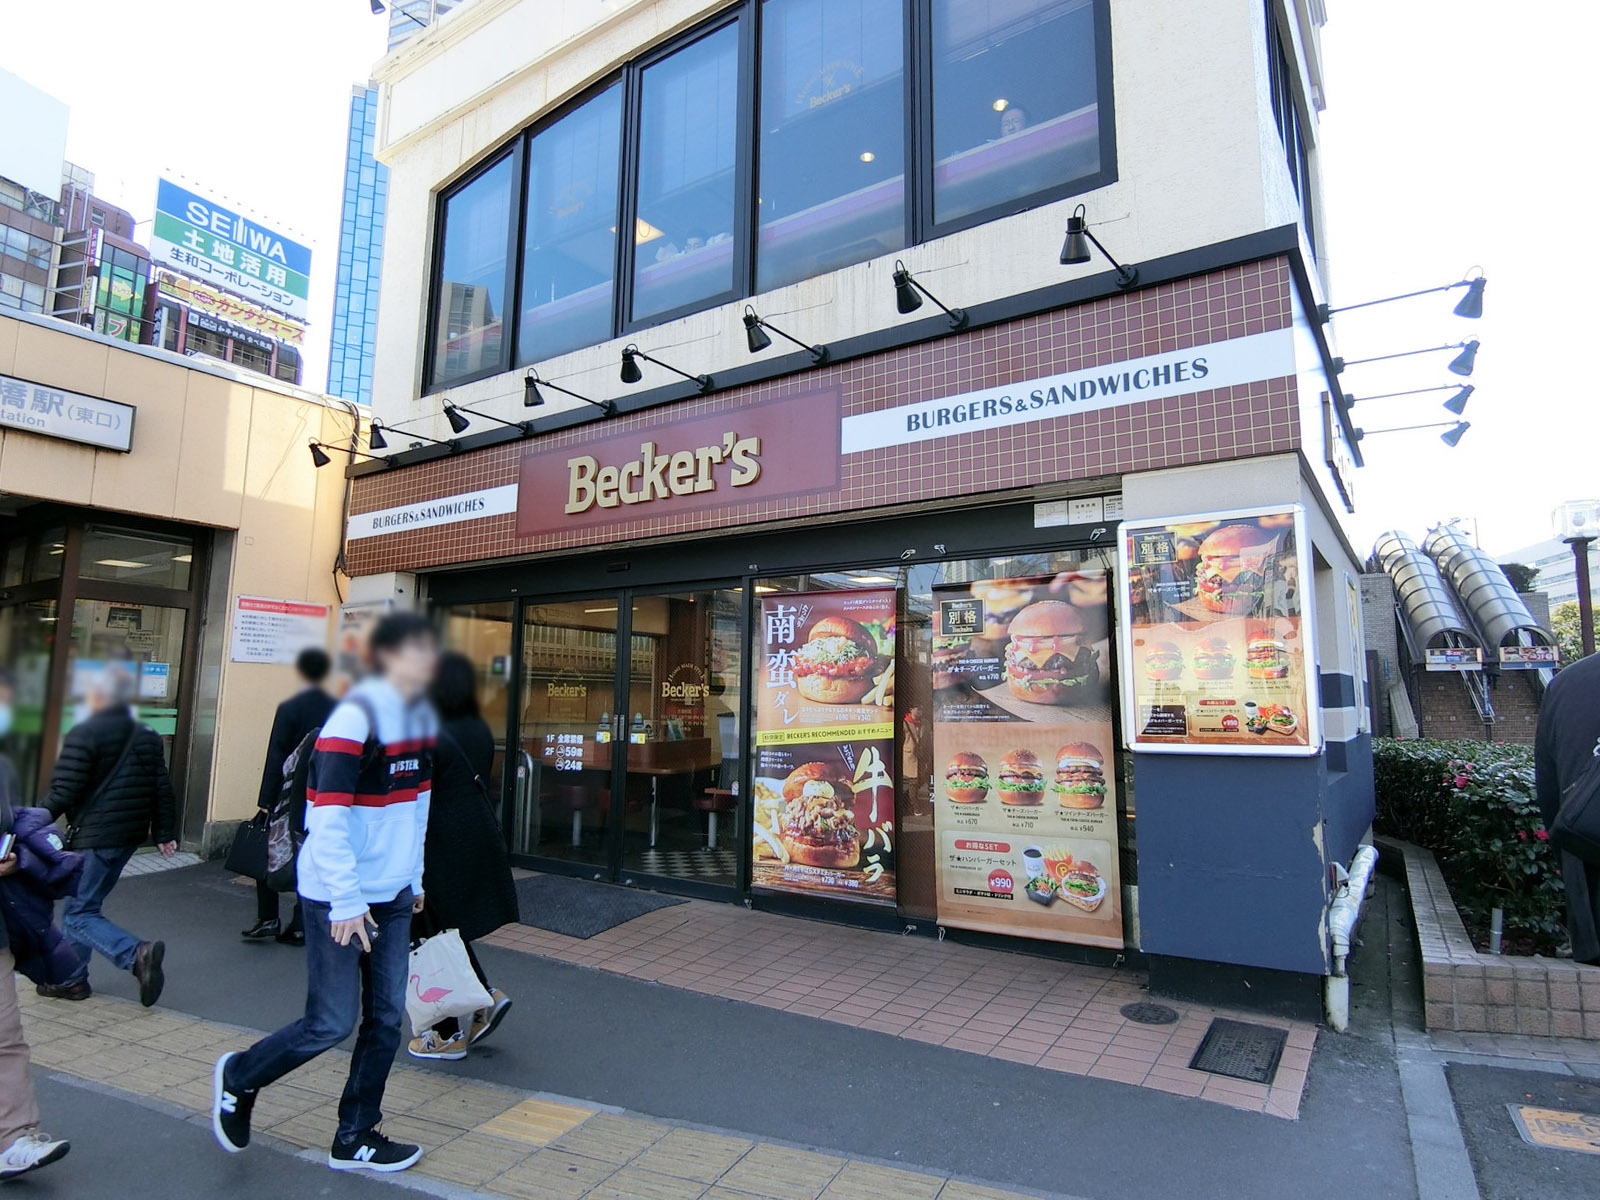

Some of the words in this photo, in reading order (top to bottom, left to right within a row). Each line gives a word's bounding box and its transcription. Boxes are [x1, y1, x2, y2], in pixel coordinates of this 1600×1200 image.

[183, 229, 288, 288] 土地活用
[170, 246, 294, 307] 生和コーポレーション
[907, 357, 1209, 433] BURGERS&SANDWICHES
[565, 431, 761, 514] Becker's
[372, 497, 485, 530] BURGERS&SANDWICHES
[948, 610, 977, 625] 別格
[547, 683, 587, 697] Becker's
[661, 682, 710, 697] Becker's
[546, 734, 555, 743] 1F
[811, 729, 856, 738] RECOMMENDED
[544, 747, 555, 756] 2F
[990, 877, 1012, 888] ¥990
[353, 1145, 376, 1162] N
